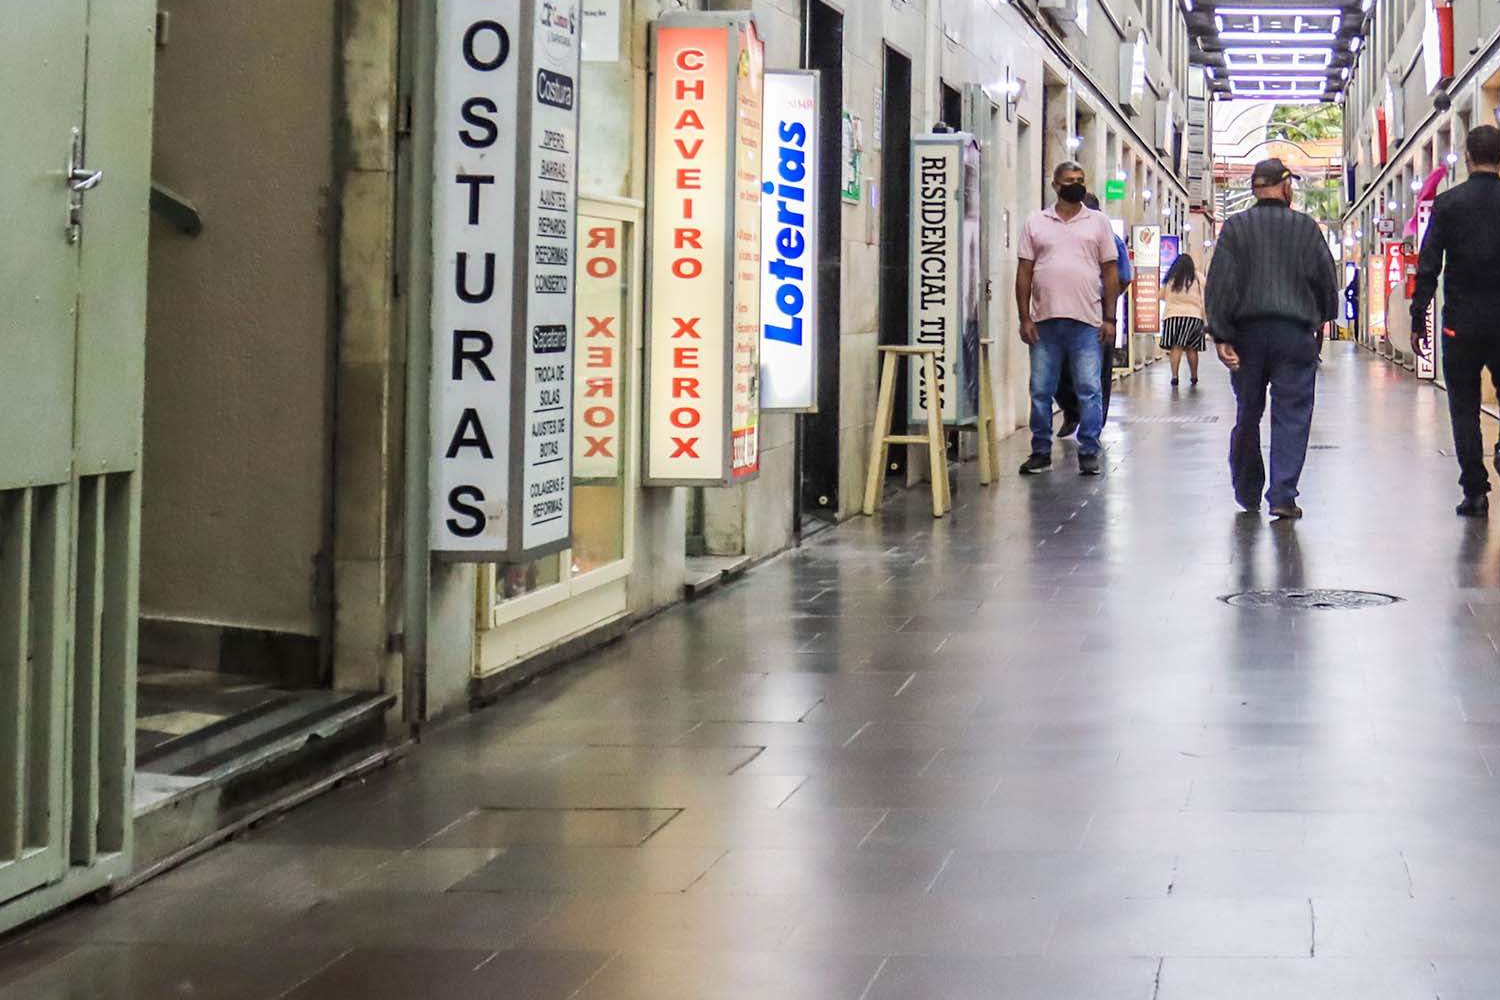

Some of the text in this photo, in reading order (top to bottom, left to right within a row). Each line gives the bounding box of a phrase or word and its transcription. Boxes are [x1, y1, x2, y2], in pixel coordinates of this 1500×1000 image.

[538, 71, 572, 105] Costura
[541, 160, 566, 178] BARRAS
[538, 217, 567, 235] REPAROS
[761, 120, 806, 347] Loterias
[920, 155, 946, 310] RESIDENCIAL
[536, 245, 568, 263] REFORMAS
[668, 49, 704, 460] CHAVEIRO XEROX
[534, 327, 567, 351] Sapataria
[535, 365, 564, 384] TROCA DE
[540, 389, 560, 406] SOLAS
[532, 418, 565, 437] AJUSTES DE
[540, 441, 559, 458] BOTAS
[533, 498, 562, 518] REFORMAS
